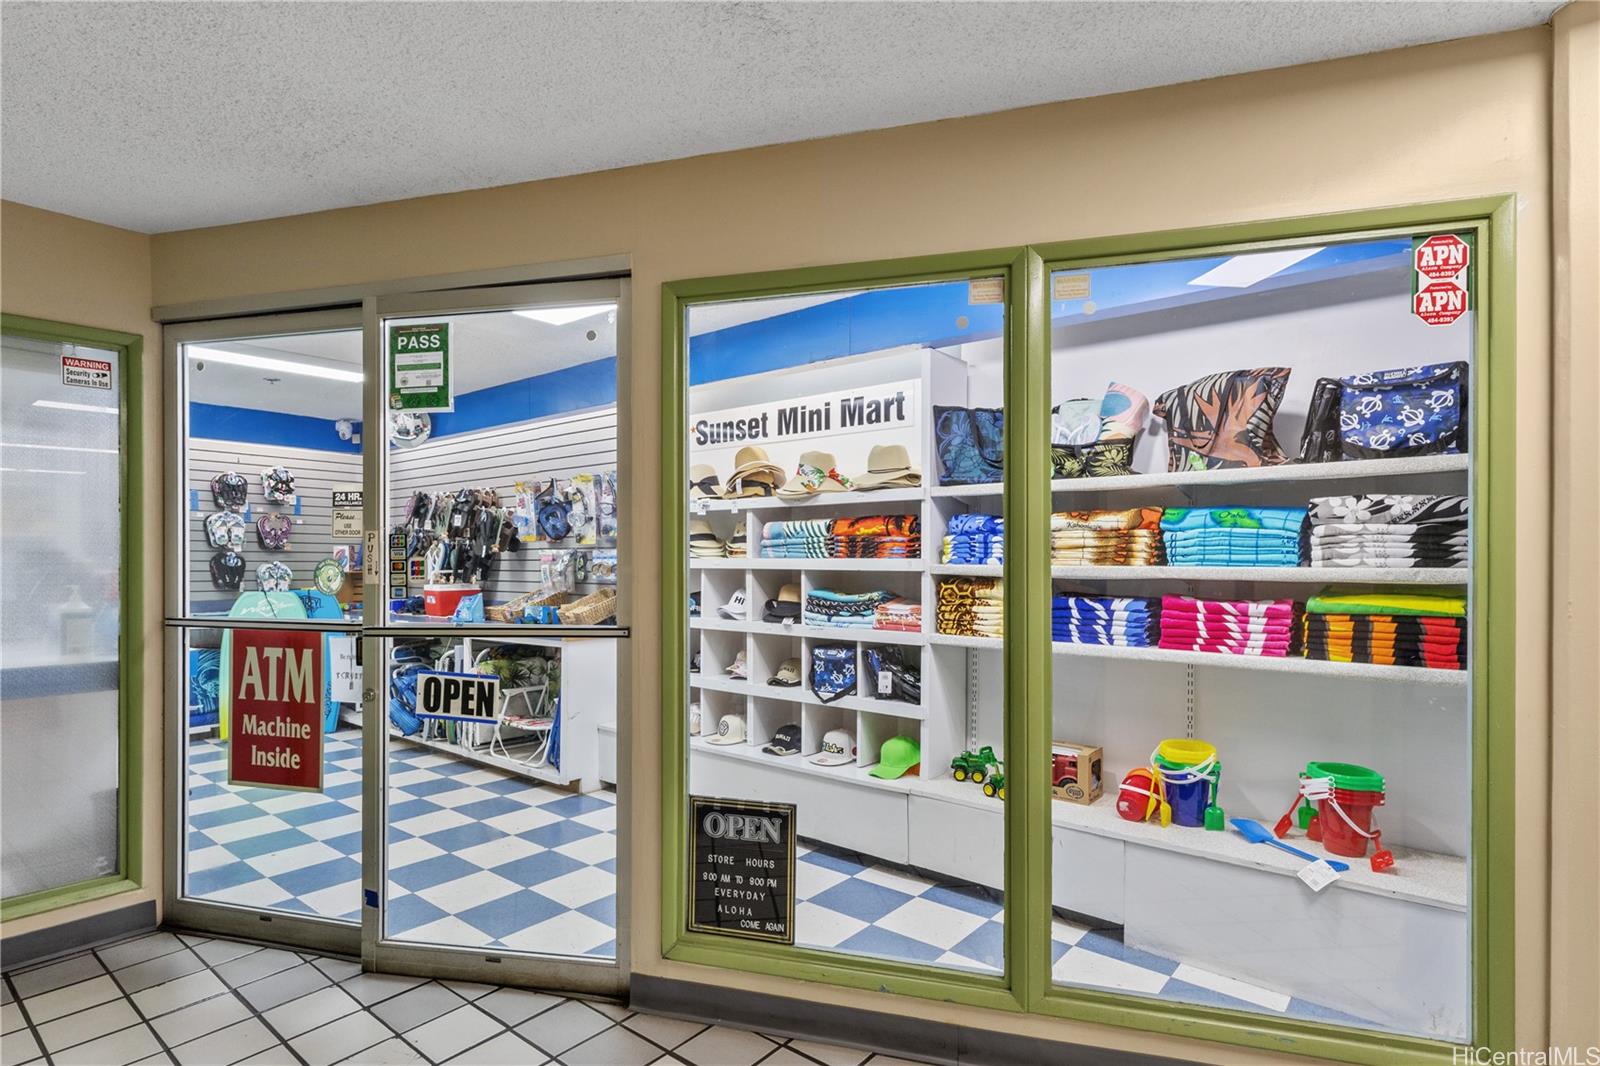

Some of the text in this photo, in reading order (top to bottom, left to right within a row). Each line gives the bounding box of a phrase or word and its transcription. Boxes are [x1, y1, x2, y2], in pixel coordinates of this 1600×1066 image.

[1420, 244, 1465, 267] APN
[1419, 290, 1464, 313] APN
[397, 334, 441, 350] PASS
[64, 358, 109, 370] WARNING
[66, 368, 90, 379] Security
[66, 376, 91, 386] Cameras
[695, 391, 905, 446] Sunset Mini Mart
[334, 493, 346, 501] 24
[238, 646, 316, 704] ATM
[423, 676, 495, 718] OPEN
[242, 713, 311, 740] Machine
[251, 744, 301, 770] Inside
[702, 811, 783, 844] OPEN
[708, 854, 776, 870] STORE HOURS
[720, 873, 731, 883] AM
[735, 875, 744, 885] TO
[766, 878, 777, 889] PM
[714, 887, 766, 902] EVERYDAY
[717, 904, 753, 917] ALOHA
[740, 919, 785, 934] COME AGAIN
